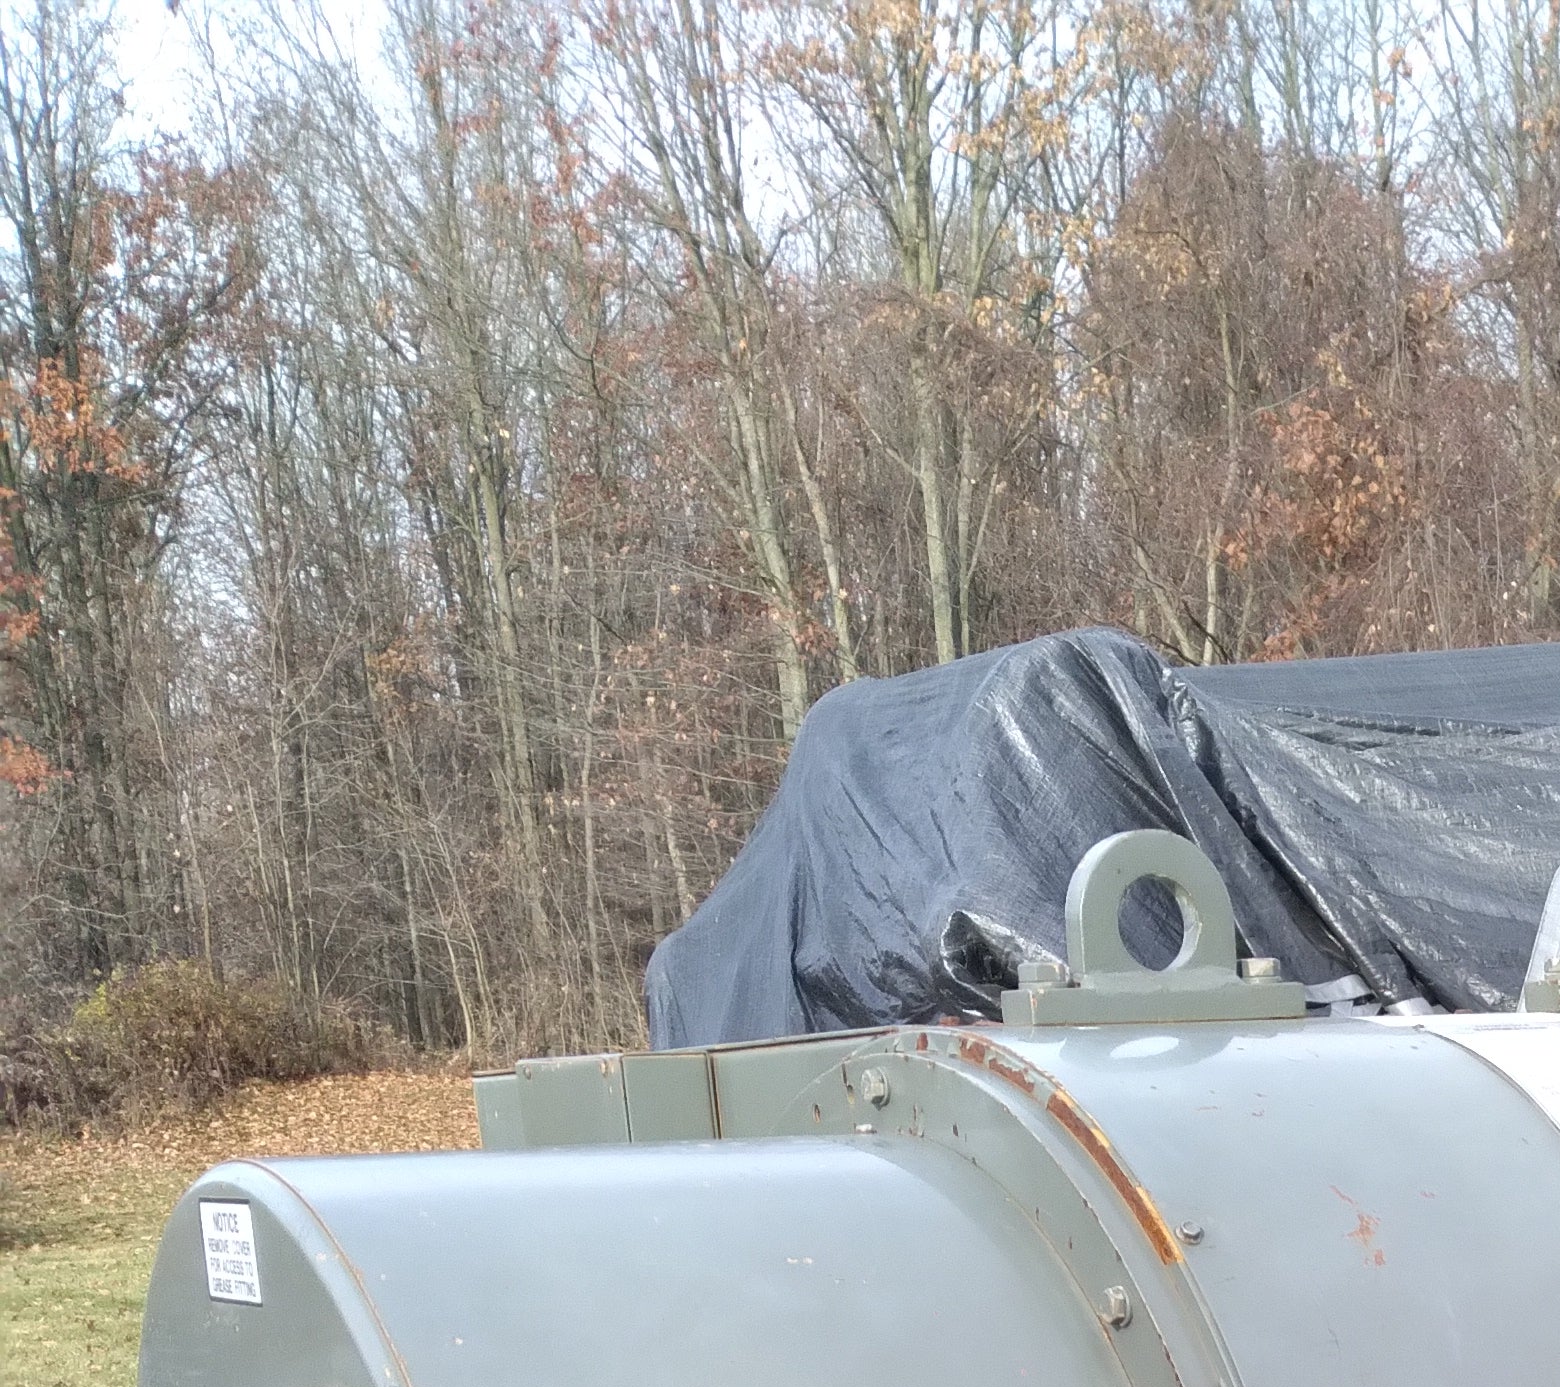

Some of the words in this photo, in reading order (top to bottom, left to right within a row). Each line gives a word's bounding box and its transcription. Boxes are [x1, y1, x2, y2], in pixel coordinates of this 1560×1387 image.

[213, 1212, 240, 1233] NOTICE
[208, 1238, 229, 1254] REMOVE
[232, 1239, 252, 1256] COVER
[210, 1257, 221, 1272] FOR
[222, 1258, 244, 1275] ACCESS
[244, 1261, 254, 1277] TO
[212, 1277, 233, 1294] GREASE
[234, 1279, 257, 1297] FITTING
